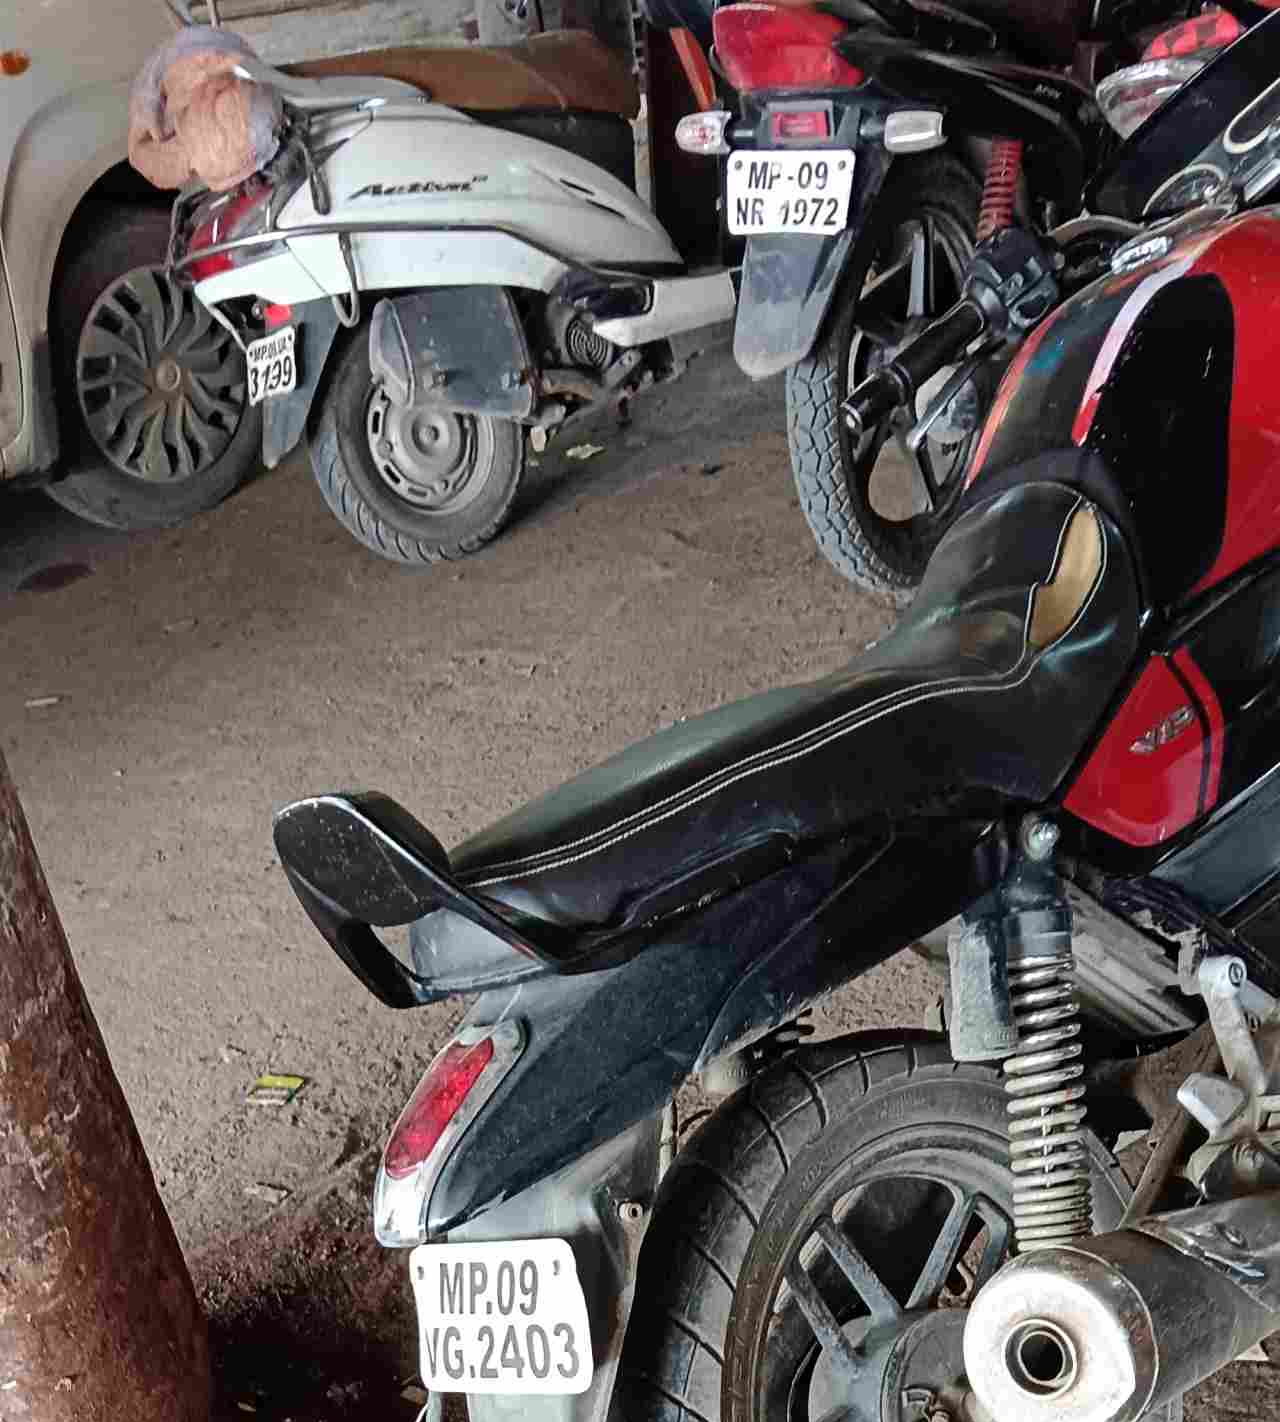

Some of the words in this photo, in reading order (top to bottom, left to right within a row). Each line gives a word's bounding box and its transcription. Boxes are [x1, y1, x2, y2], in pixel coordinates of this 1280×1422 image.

[780, 197, 839, 226] 1972
[439, 1258, 539, 1316] MP.09
[424, 1322, 580, 1380] VG.2403
